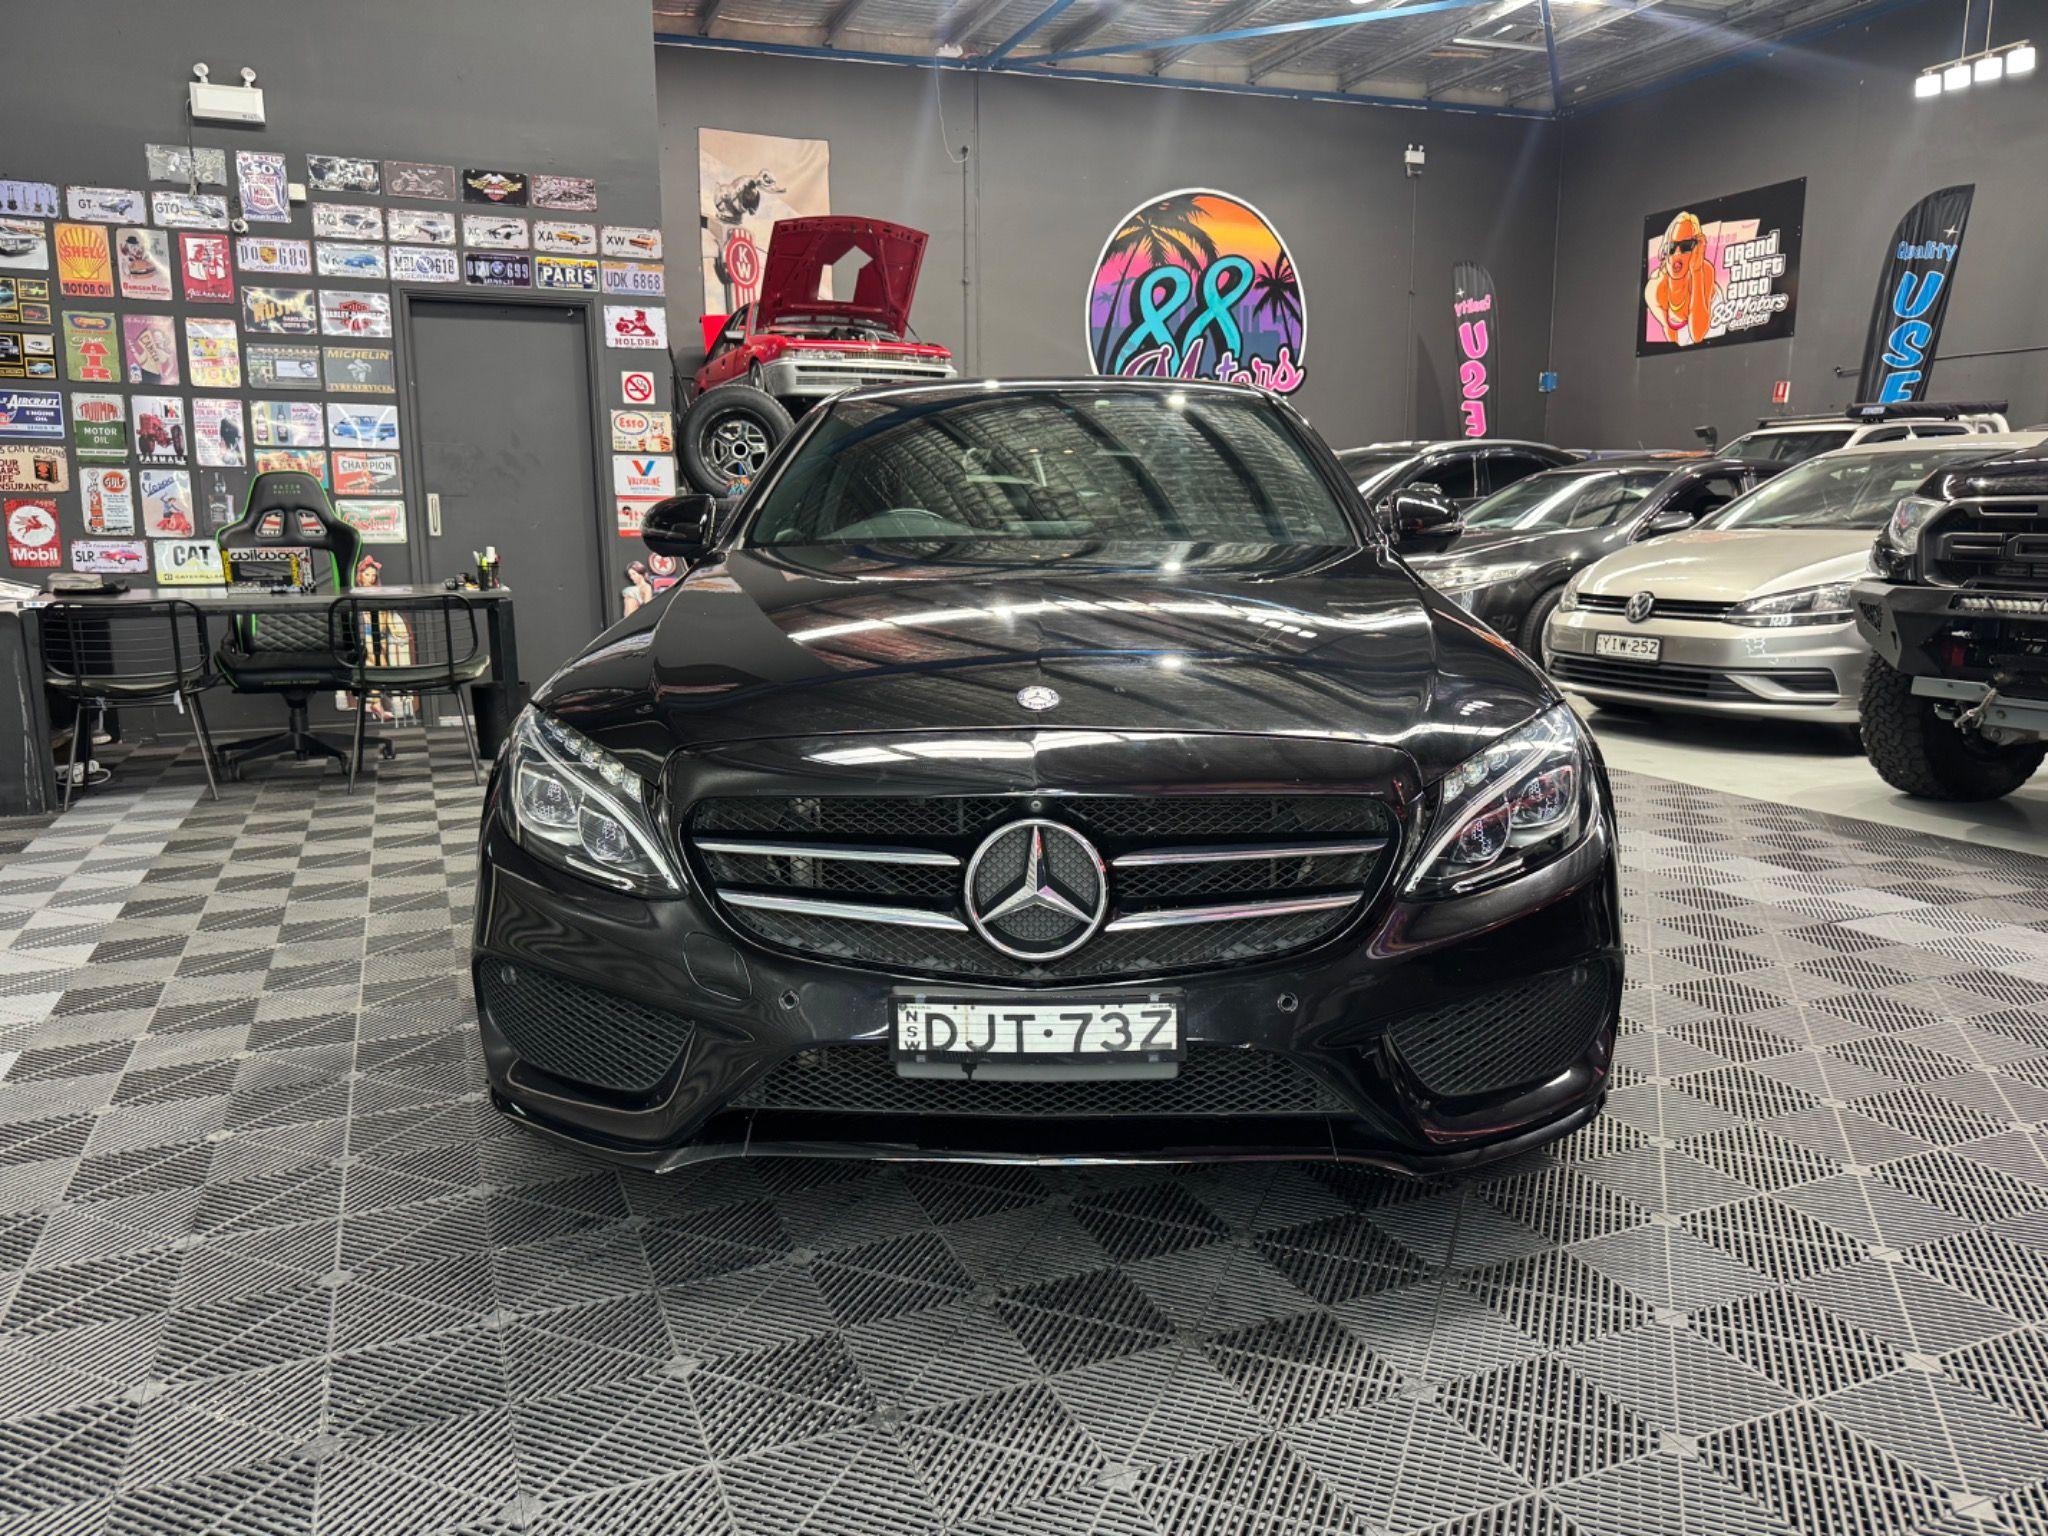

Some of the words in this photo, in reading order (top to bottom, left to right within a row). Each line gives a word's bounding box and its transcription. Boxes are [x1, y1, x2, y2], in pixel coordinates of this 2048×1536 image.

[155, 202, 180, 214] GTO
[538, 231, 554, 242] XA
[606, 235, 625, 246] XW
[64, 246, 104, 260] SHELL
[542, 266, 594, 283] PARIS
[605, 270, 628, 288] UDK
[633, 272, 661, 290] 6868
[63, 282, 96, 295] MOTOR
[614, 337, 659, 347] HOLDEN
[327, 351, 389, 360] MICHELIN
[6, 394, 59, 410] AIRCRAFT
[84, 427, 117, 436] MOTOR
[94, 436, 110, 445] OIL
[341, 460, 393, 471] CHAMPION
[104, 478, 127, 489] GULF
[12, 547, 59, 562] Mobil
[75, 550, 95, 562] SLR
[173, 545, 211, 567] CAT
